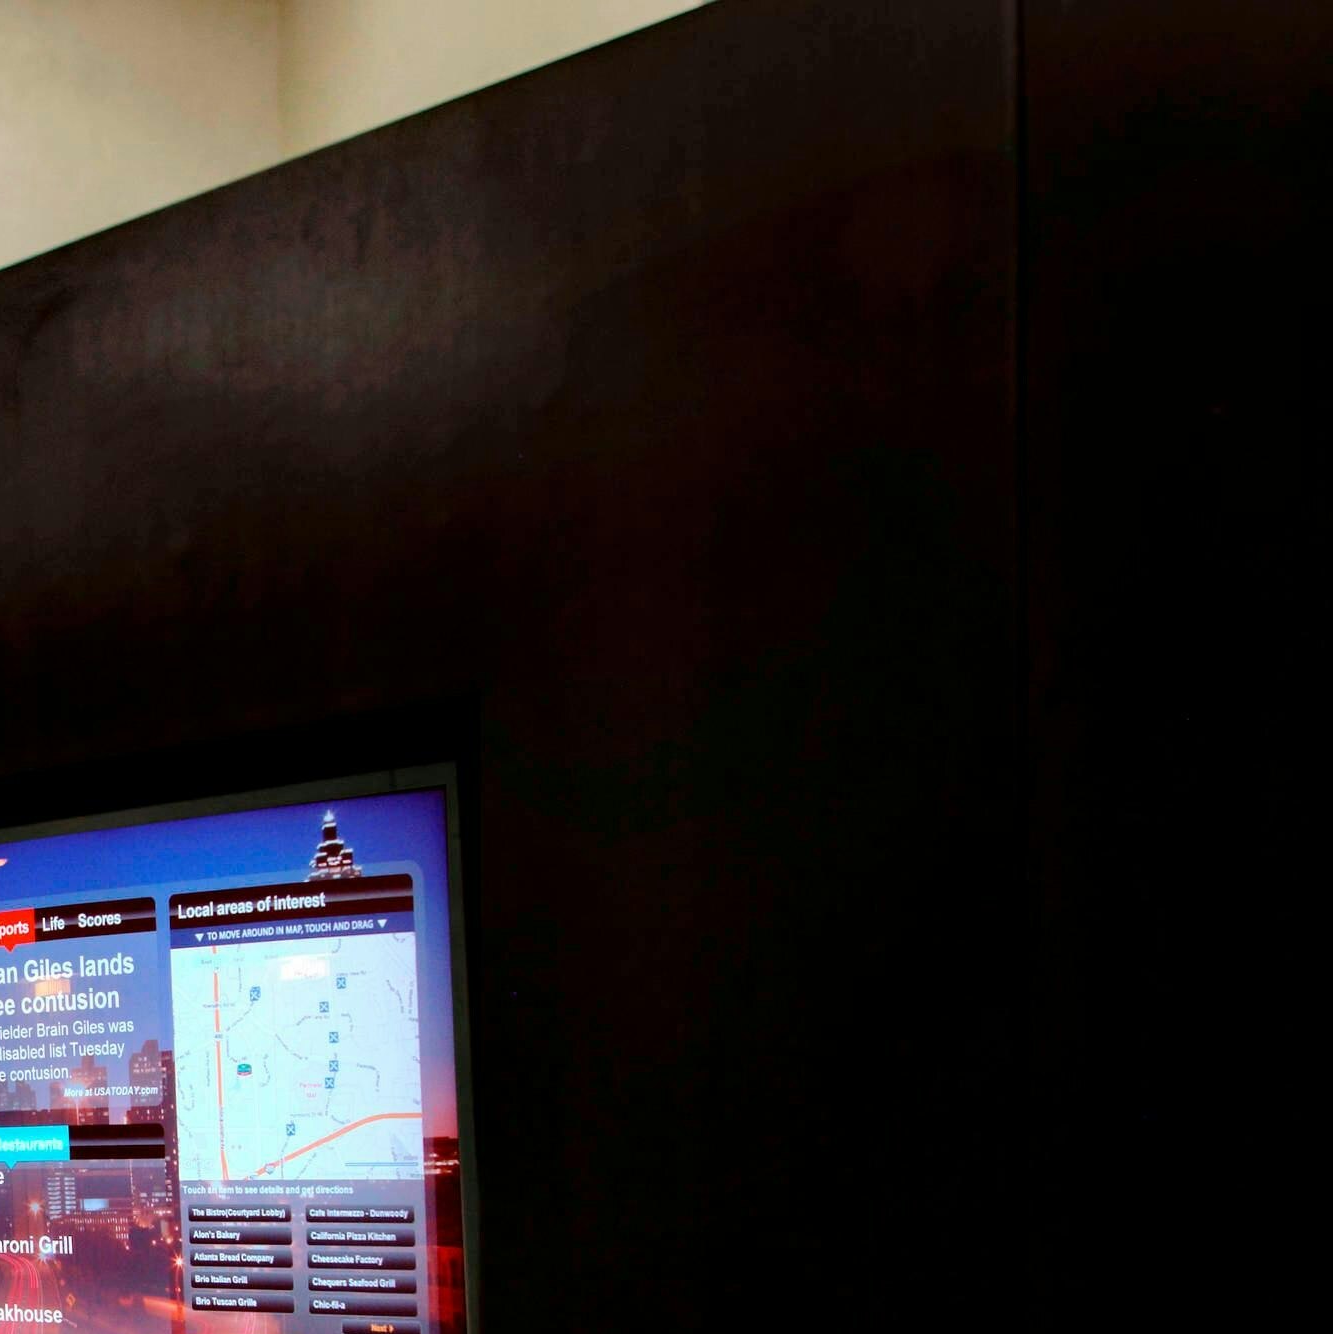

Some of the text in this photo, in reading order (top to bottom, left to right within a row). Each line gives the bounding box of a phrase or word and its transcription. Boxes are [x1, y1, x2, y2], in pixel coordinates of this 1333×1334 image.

[178, 892, 325, 919] Local areas of interest
[42, 916, 65, 931] Life
[78, 913, 121, 928] Scores
[207, 919, 373, 940] TO MOVE AROUND IN MAP, TOUCH AND DRAG
[24, 958, 73, 982] Giles
[80, 953, 134, 977] lands
[21, 988, 119, 1014] contusion
[37, 1022, 69, 1037] Brain
[73, 1021, 104, 1035] Giles
[108, 1021, 134, 1032] was
[50, 1044, 67, 1057] list
[69, 1041, 124, 1058] Tuesday
[10, 1065, 72, 1081] contusion.
[94, 1087, 158, 1096] USATODAY.com
[183, 1186, 205, 1194] Touch
[316, 1186, 353, 1194] directions
[370, 1210, 408, 1219] Dunwoody
[216, 1231, 240, 1240] Bakery
[311, 1232, 396, 1240] California Pizza Kitchen
[39, 1236, 73, 1254] Grill
[194, 1253, 274, 1263] Atlanta Bread Company
[312, 1255, 383, 1266] Cheesecake Factory
[195, 1275, 209, 1283] Brio
[233, 1276, 248, 1284] Grill
[312, 1278, 396, 1288] Chequers Seafood Grill
